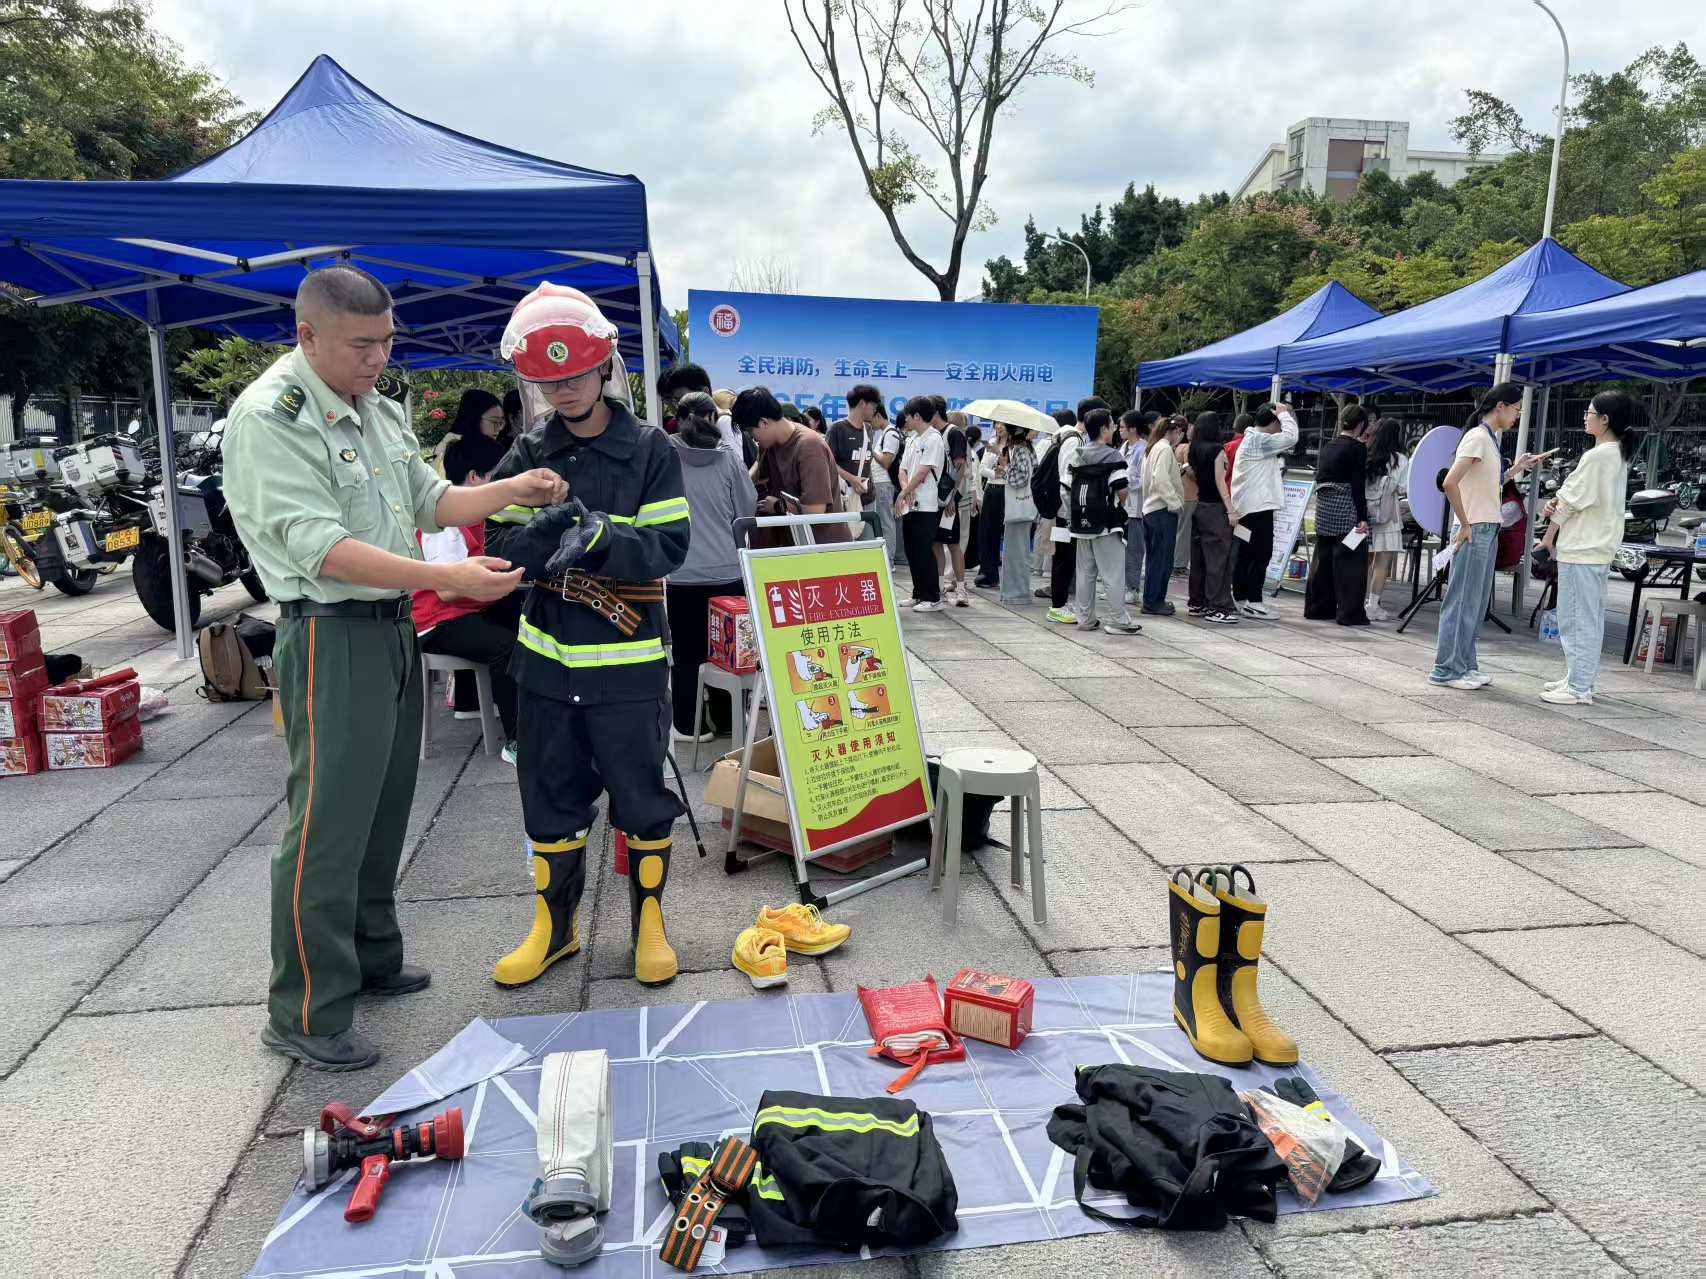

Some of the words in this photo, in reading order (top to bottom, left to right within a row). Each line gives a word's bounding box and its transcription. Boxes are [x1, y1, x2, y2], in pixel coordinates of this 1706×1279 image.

[805, 580, 876, 609] 灭火器
[808, 612, 827, 621] FIRE
[800, 621, 861, 645] 使用方法
[811, 731, 896, 763] 灭火器使用须知
